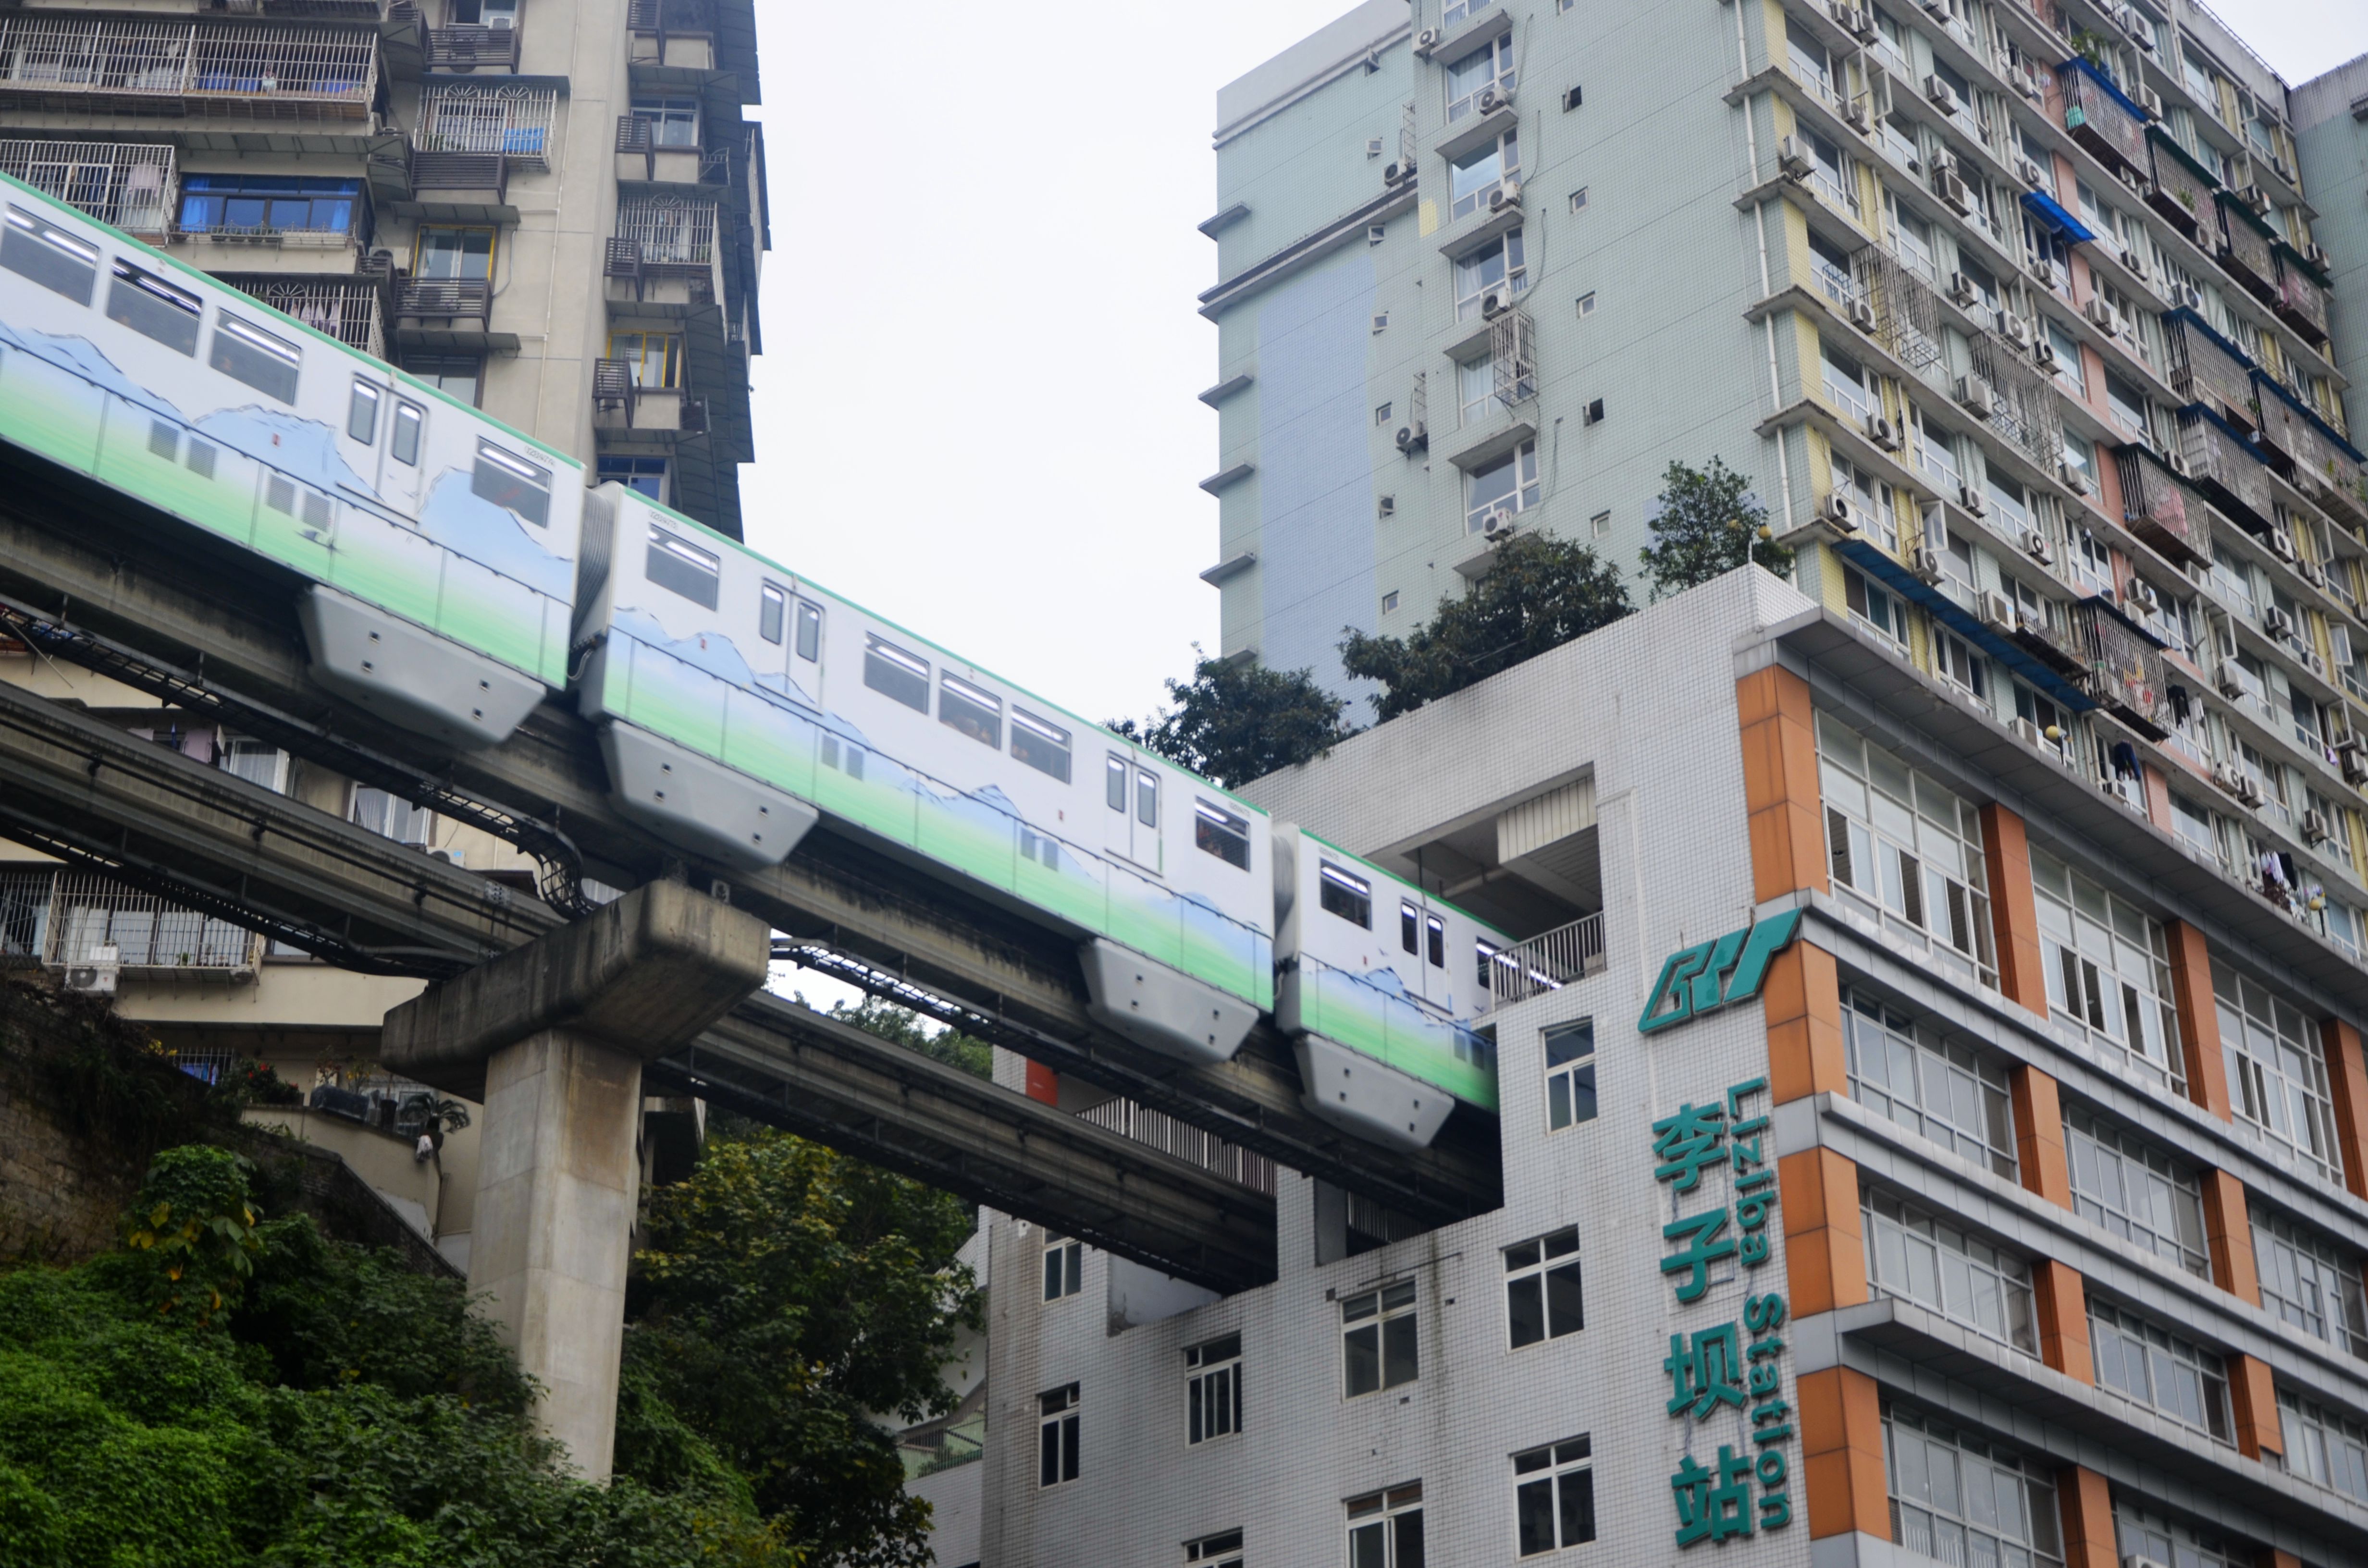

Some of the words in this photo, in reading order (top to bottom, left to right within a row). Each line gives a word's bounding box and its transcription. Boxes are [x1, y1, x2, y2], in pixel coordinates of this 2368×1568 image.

[1727, 1077, 1772, 1266] Liziba
[1652, 1102, 1751, 1546] 李子坝站
[1744, 1293, 1792, 1529] Station
